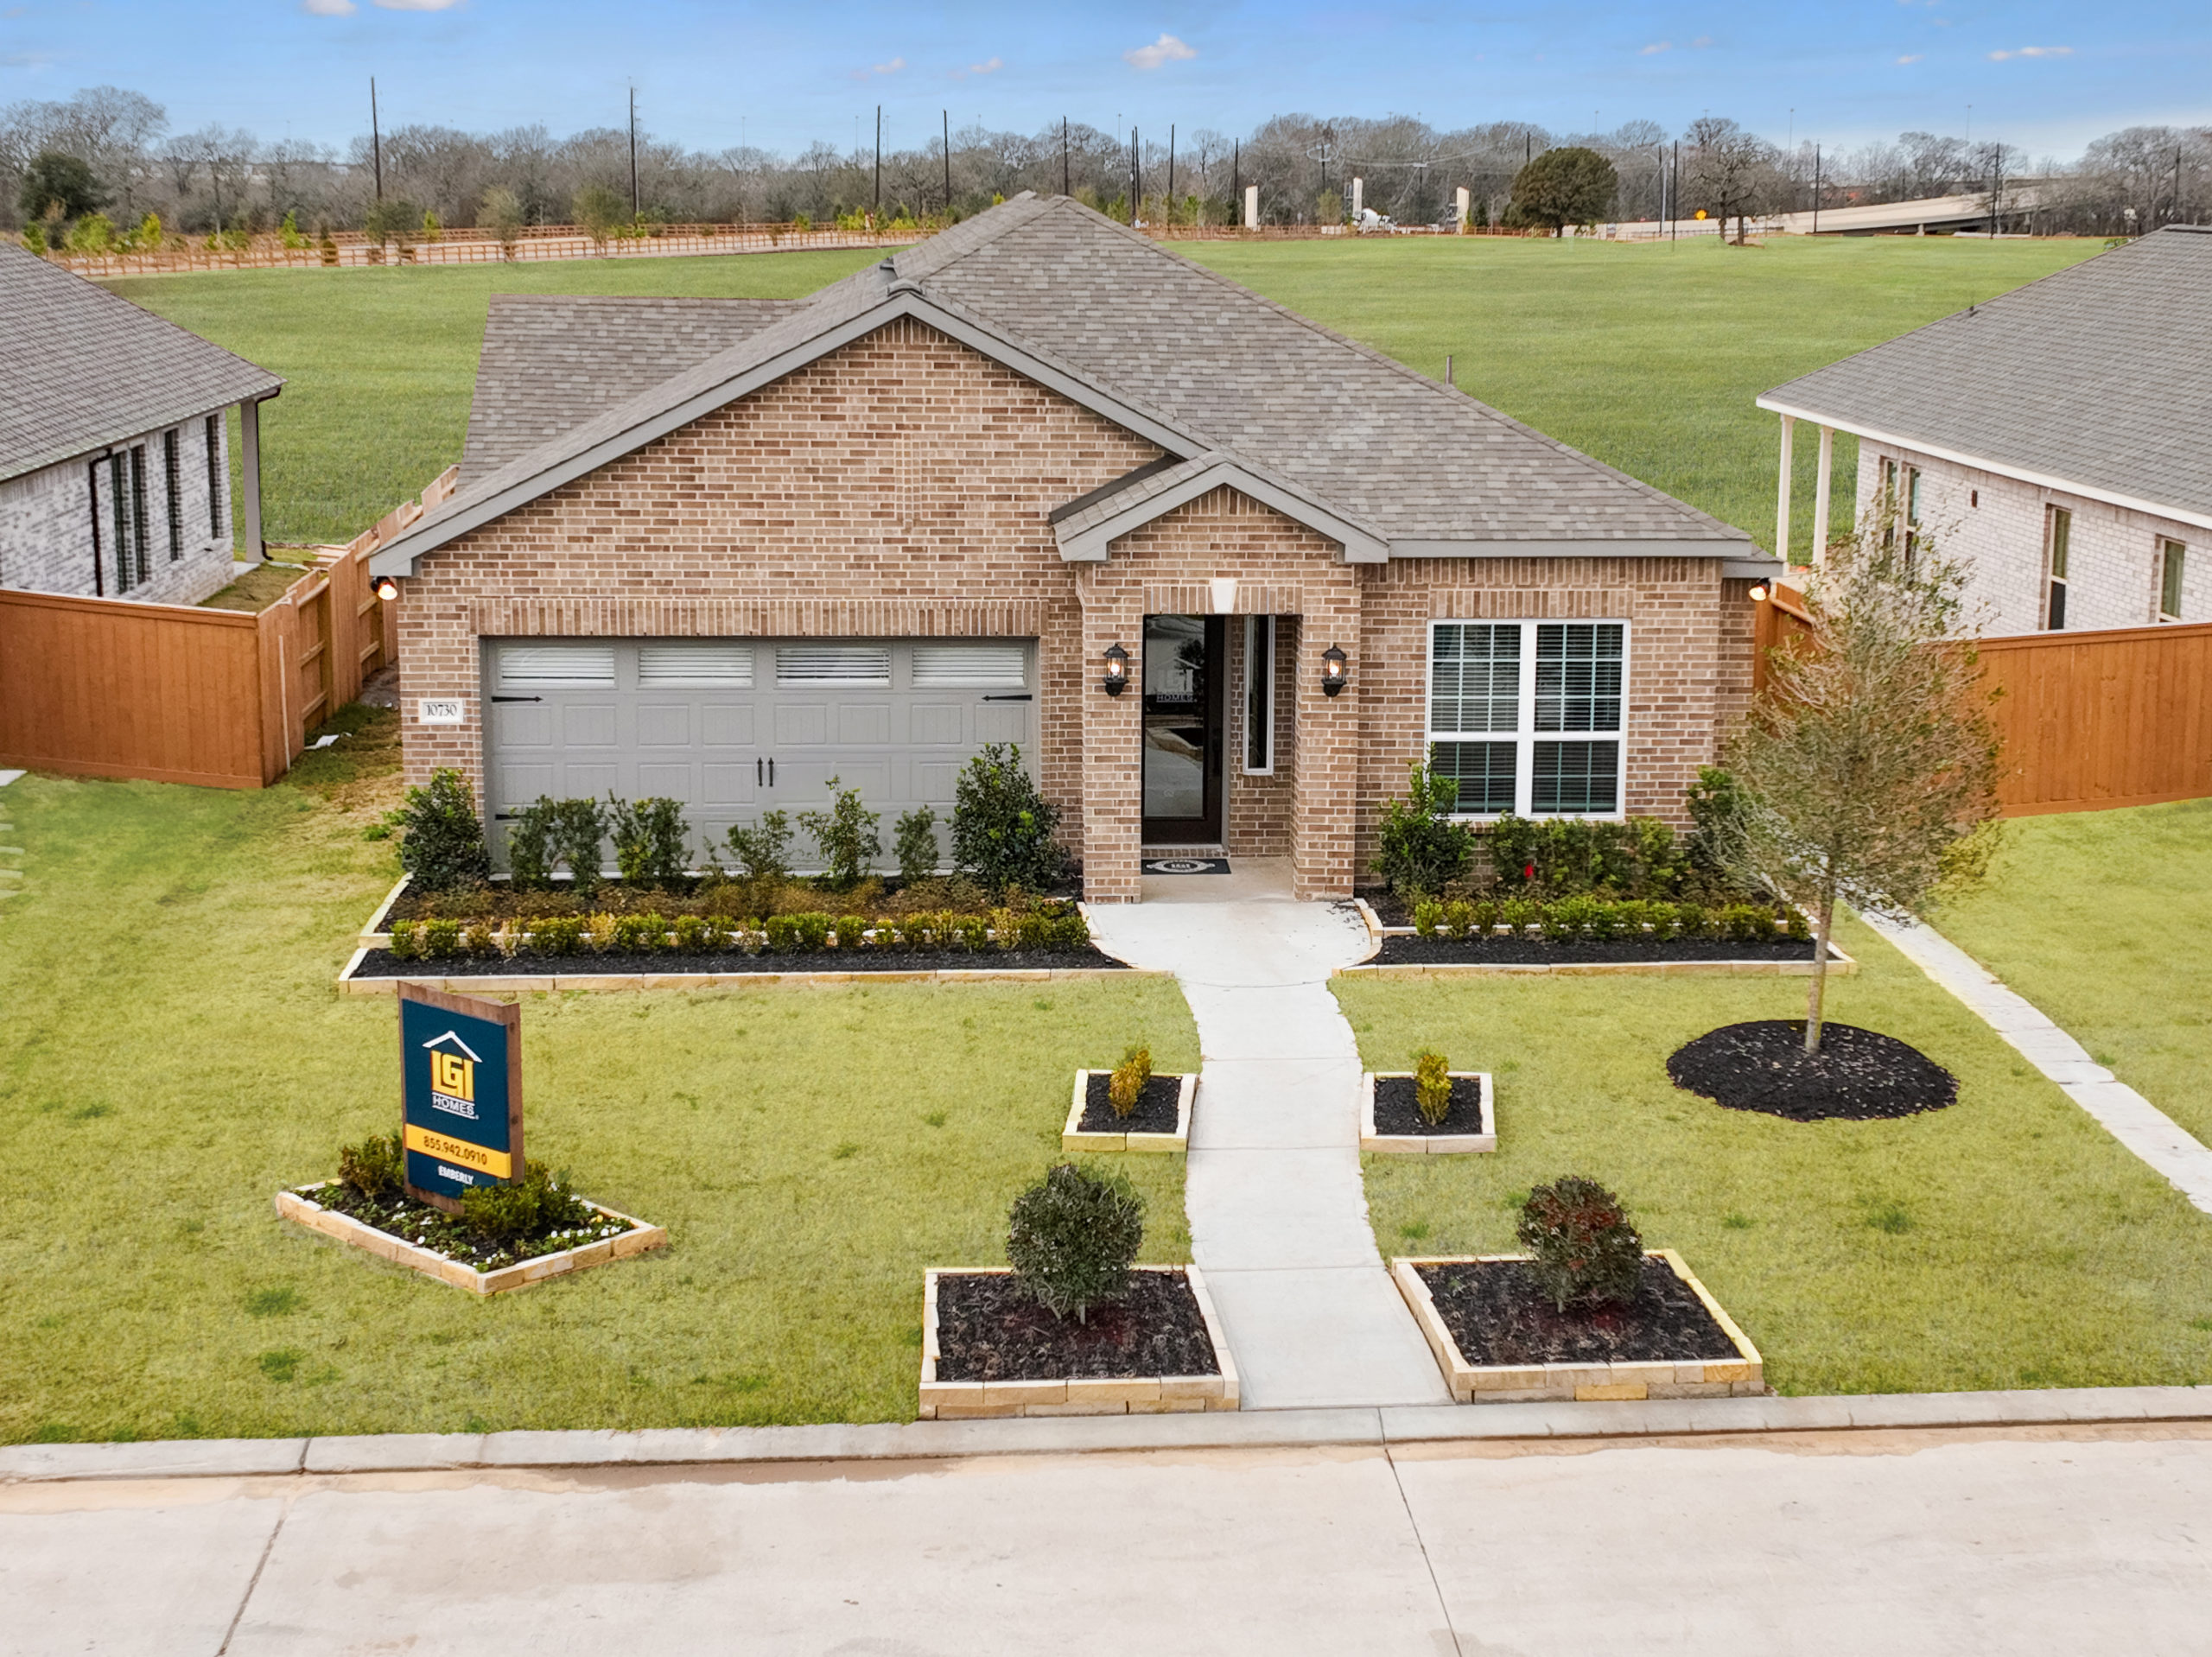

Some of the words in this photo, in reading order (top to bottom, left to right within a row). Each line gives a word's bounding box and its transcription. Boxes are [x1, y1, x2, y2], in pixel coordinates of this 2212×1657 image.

[426, 704, 457, 716] 10730
[431, 1050, 474, 1101] LGI
[433, 1095, 475, 1115] HOMES
[423, 1135, 488, 1165] 855.942.0910
[438, 1165, 474, 1185] EMBERLY
